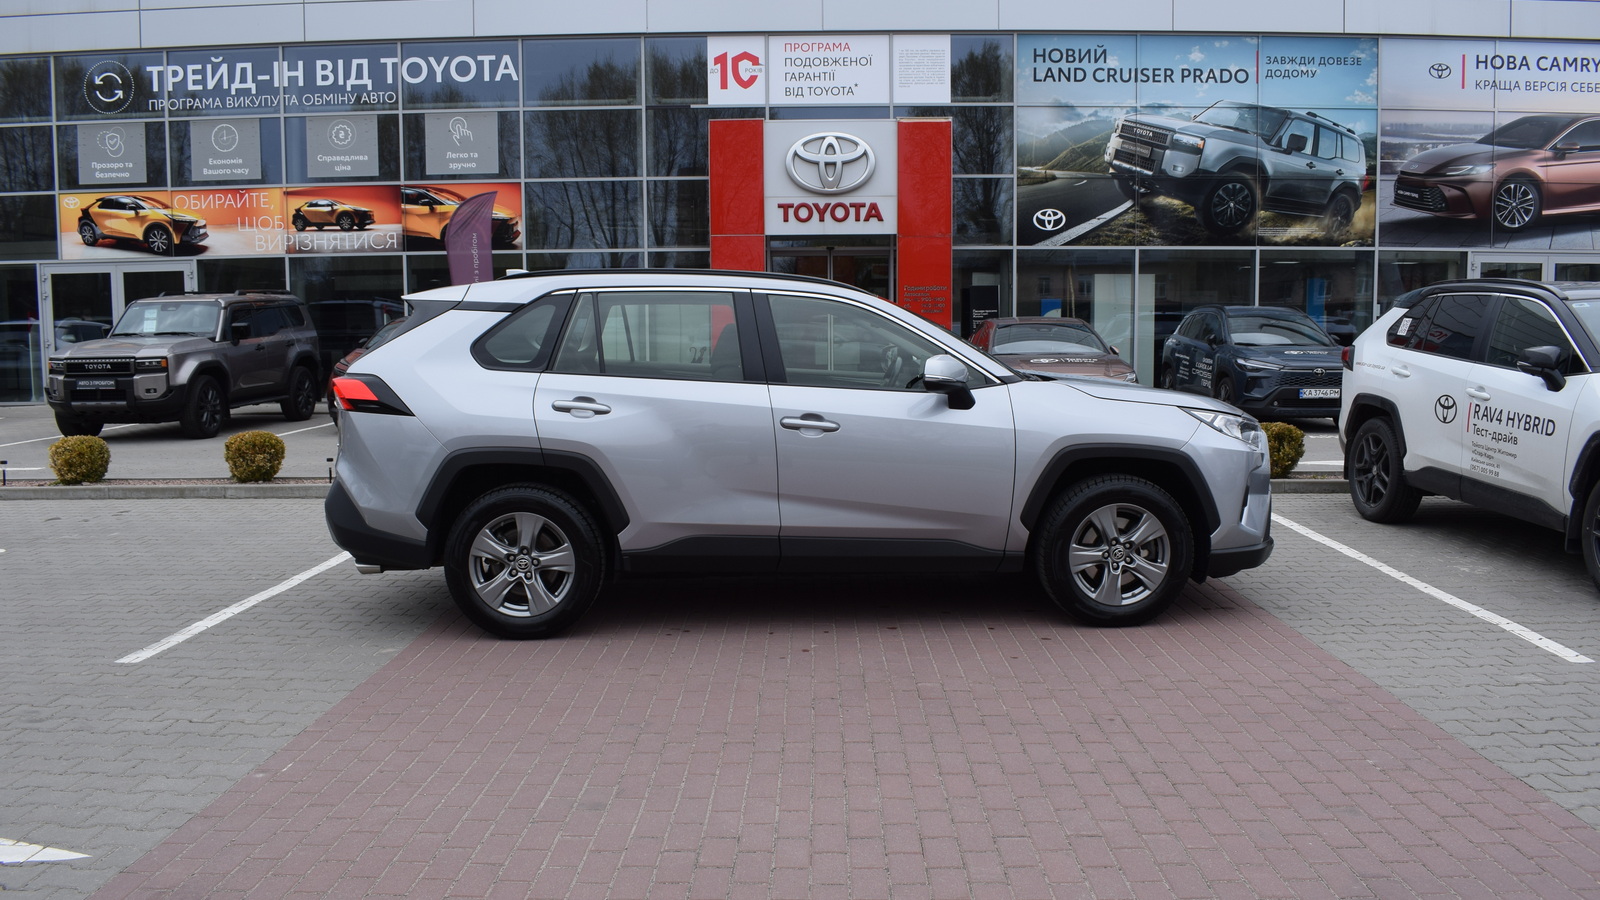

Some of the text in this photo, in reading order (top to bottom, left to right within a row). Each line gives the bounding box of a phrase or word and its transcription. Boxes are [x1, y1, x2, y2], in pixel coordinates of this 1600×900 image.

[784, 42, 851, 53] ПРОГРАМА
[1033, 44, 1107, 64] НОВИЙ
[784, 54, 874, 69] ПОДОВЖЕНОЇ
[1265, 55, 1362, 67] ЗАВЖДИ ДОВЕЗЕ
[1475, 54, 1600, 73] НОВА CAMRY
[146, 54, 519, 95] ТРЕЙД-ІН ВІД TOYOTA
[784, 69, 836, 82] ГАРАНТІЇ
[1032, 67, 1250, 84] LAND CRUISER PRADO
[1264, 68, 1318, 80] ДОДОМУ
[784, 86, 805, 98] ВІД
[1475, 79, 1600, 93] КРАЩА ВЕРСІЯ СЕБЕ
[149, 91, 397, 111] ПРОГРАМА ВИКУПУ ТА ОБМІНУ АВТО
[1133, 128, 1153, 137] TOYOTA
[208, 157, 243, 166] Економія
[317, 153, 369, 163] Справедлива
[446, 151, 469, 160] Легко
[91, 161, 124, 171] Прозоро
[203, 167, 250, 176] Вашого часу
[334, 163, 352, 172] ціна
[449, 161, 477, 169] зручно
[95, 170, 130, 178] безпечно
[174, 190, 275, 210] ОБИРАЙТЕ,
[777, 201, 884, 223] TOYOTA
[237, 215, 285, 233] ЩОБ
[255, 232, 398, 251] ВИРІЗНЯТИСЯ
[471, 232, 480, 269] пробігом
[1191, 367, 1212, 379] CROSS
[1473, 403, 1556, 437] RAV4 HYBRID
[1472, 423, 1519, 446] Тест-драйв
